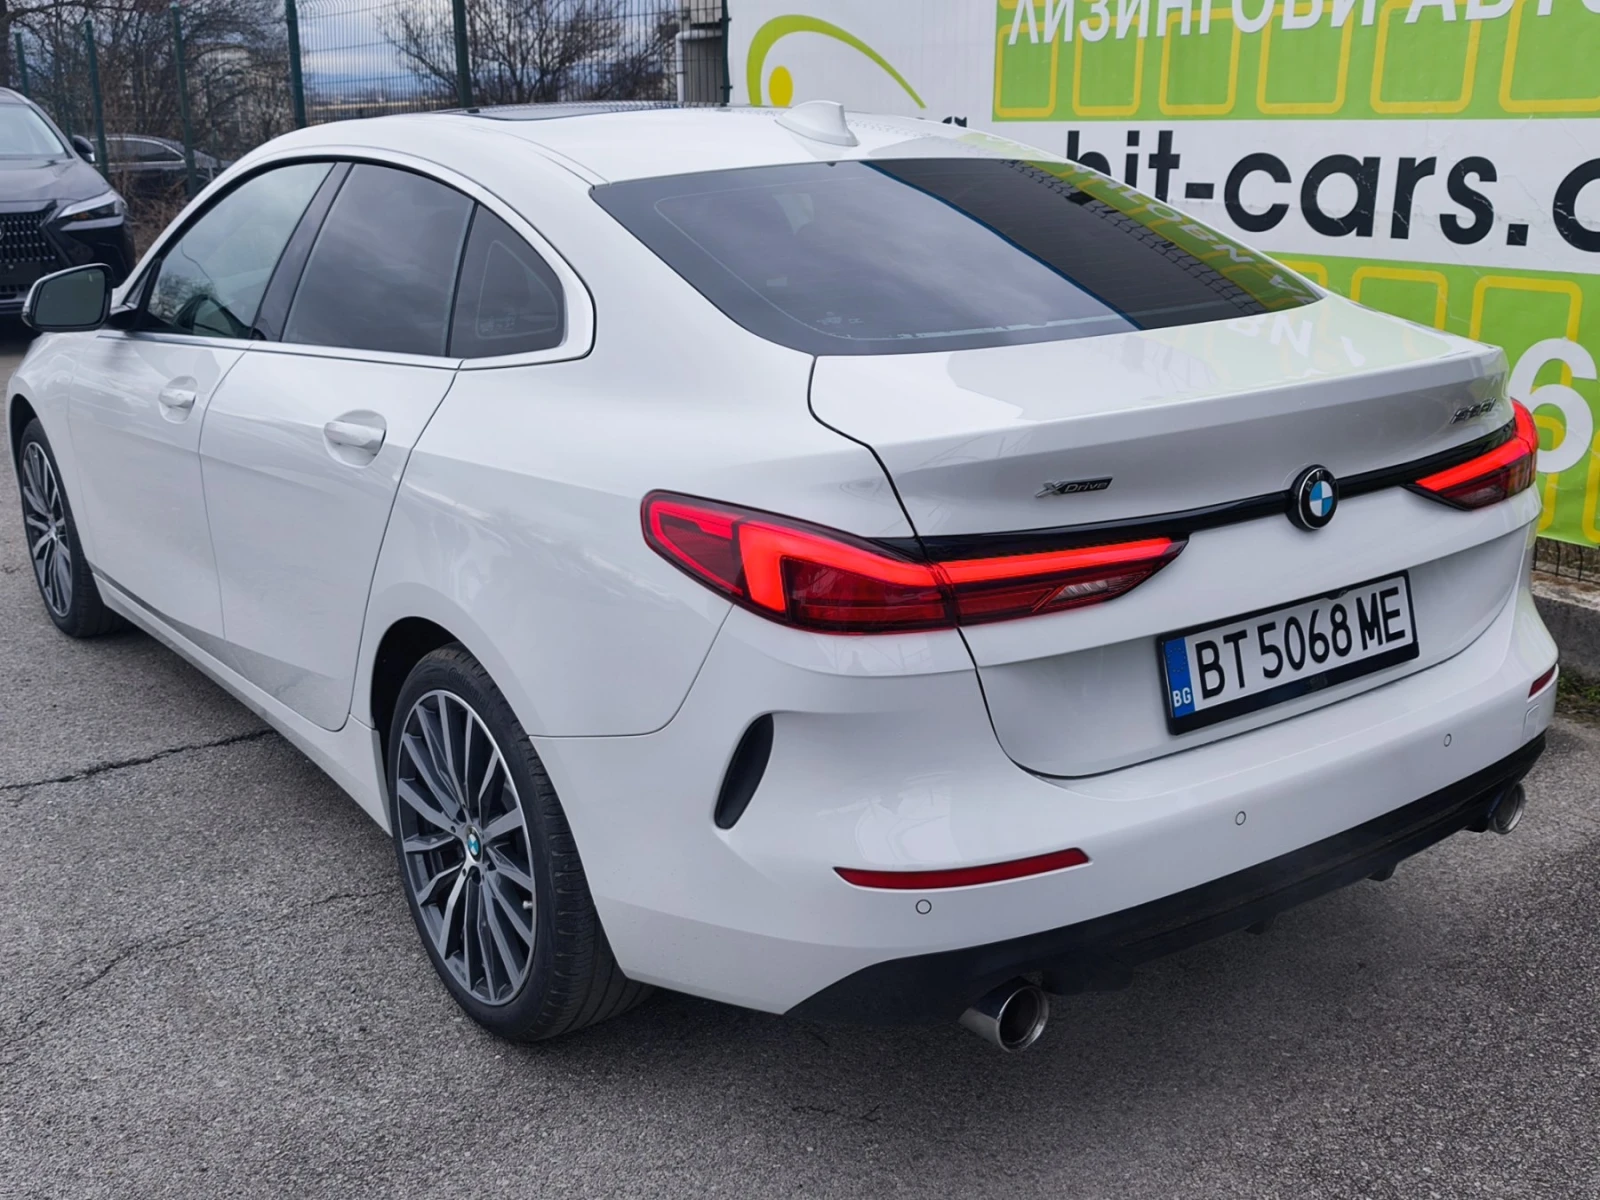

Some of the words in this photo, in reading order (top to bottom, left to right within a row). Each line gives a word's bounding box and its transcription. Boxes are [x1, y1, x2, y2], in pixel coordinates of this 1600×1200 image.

[1195, 629, 1248, 699] BT
[1257, 603, 1352, 678] 5068
[1356, 586, 1406, 650] ME
[1172, 687, 1192, 707] BG
